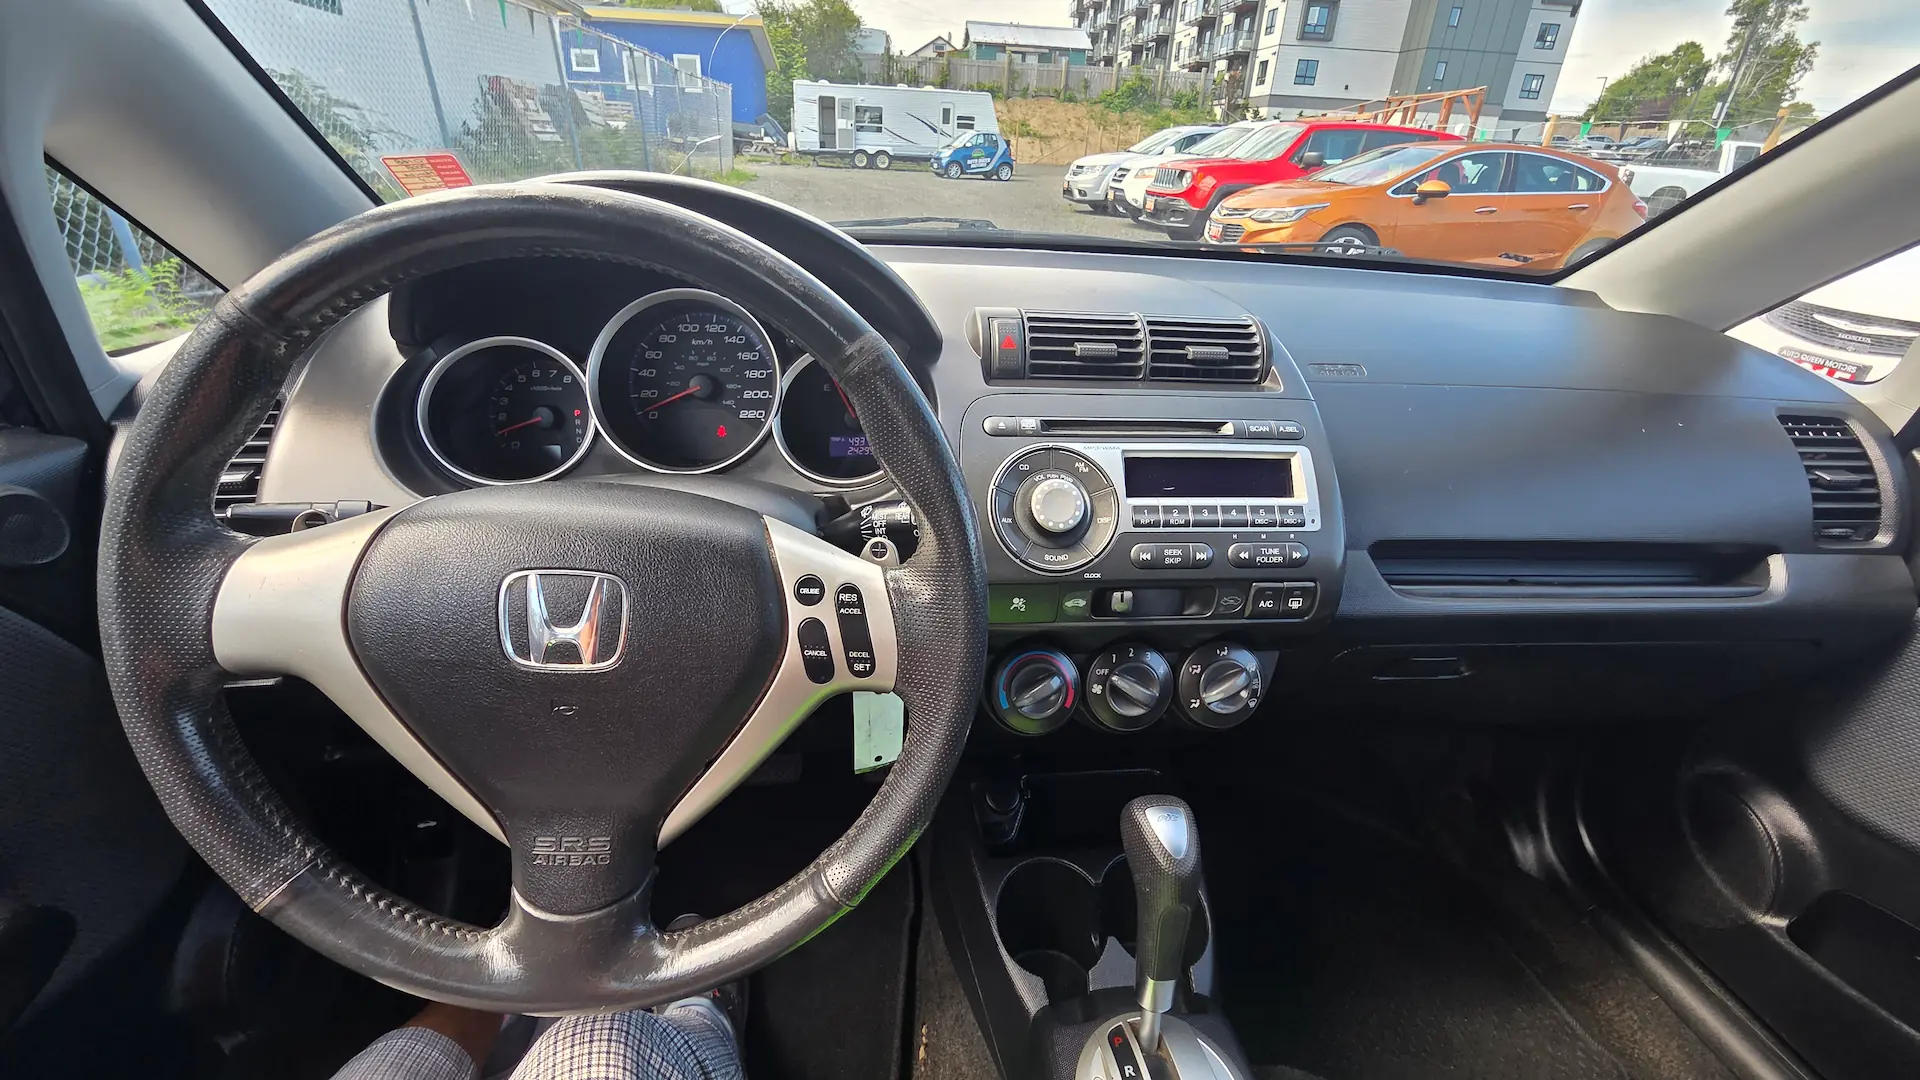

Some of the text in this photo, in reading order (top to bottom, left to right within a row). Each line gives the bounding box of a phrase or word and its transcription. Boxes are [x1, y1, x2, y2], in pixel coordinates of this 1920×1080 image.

[677, 324, 699, 332] 100
[705, 324, 727, 332] 120
[724, 336, 745, 344] 140
[737, 352, 759, 360] 160
[1781, 349, 1800, 358] AUTO
[1801, 354, 1825, 366] QUEEN
[1824, 360, 1858, 373] MOTORS
[639, 369, 656, 377] 40
[744, 370, 766, 378] 180
[563, 375, 572, 383] 8
[743, 390, 769, 398] 200
[739, 410, 765, 419] 220
[1034, 474, 1045, 482] VOL
[1143, 509, 1148, 517] 1
[1172, 509, 1179, 517] 2
[1202, 509, 1208, 517] 3
[1230, 509, 1237, 517] 4
[1259, 509, 1266, 517] 5
[1288, 509, 1294, 517] 6
[1259, 600, 1273, 608] A/C
[1129, 648, 1134, 657] 2
[1146, 652, 1151, 660] 3
[1112, 654, 1116, 663] 1
[1158, 666, 1164, 674] 4
[533, 836, 610, 851] SRS
[533, 854, 610, 865] AIRBAG
[1113, 1037, 1122, 1047] P
[1124, 1065, 1136, 1077] R
